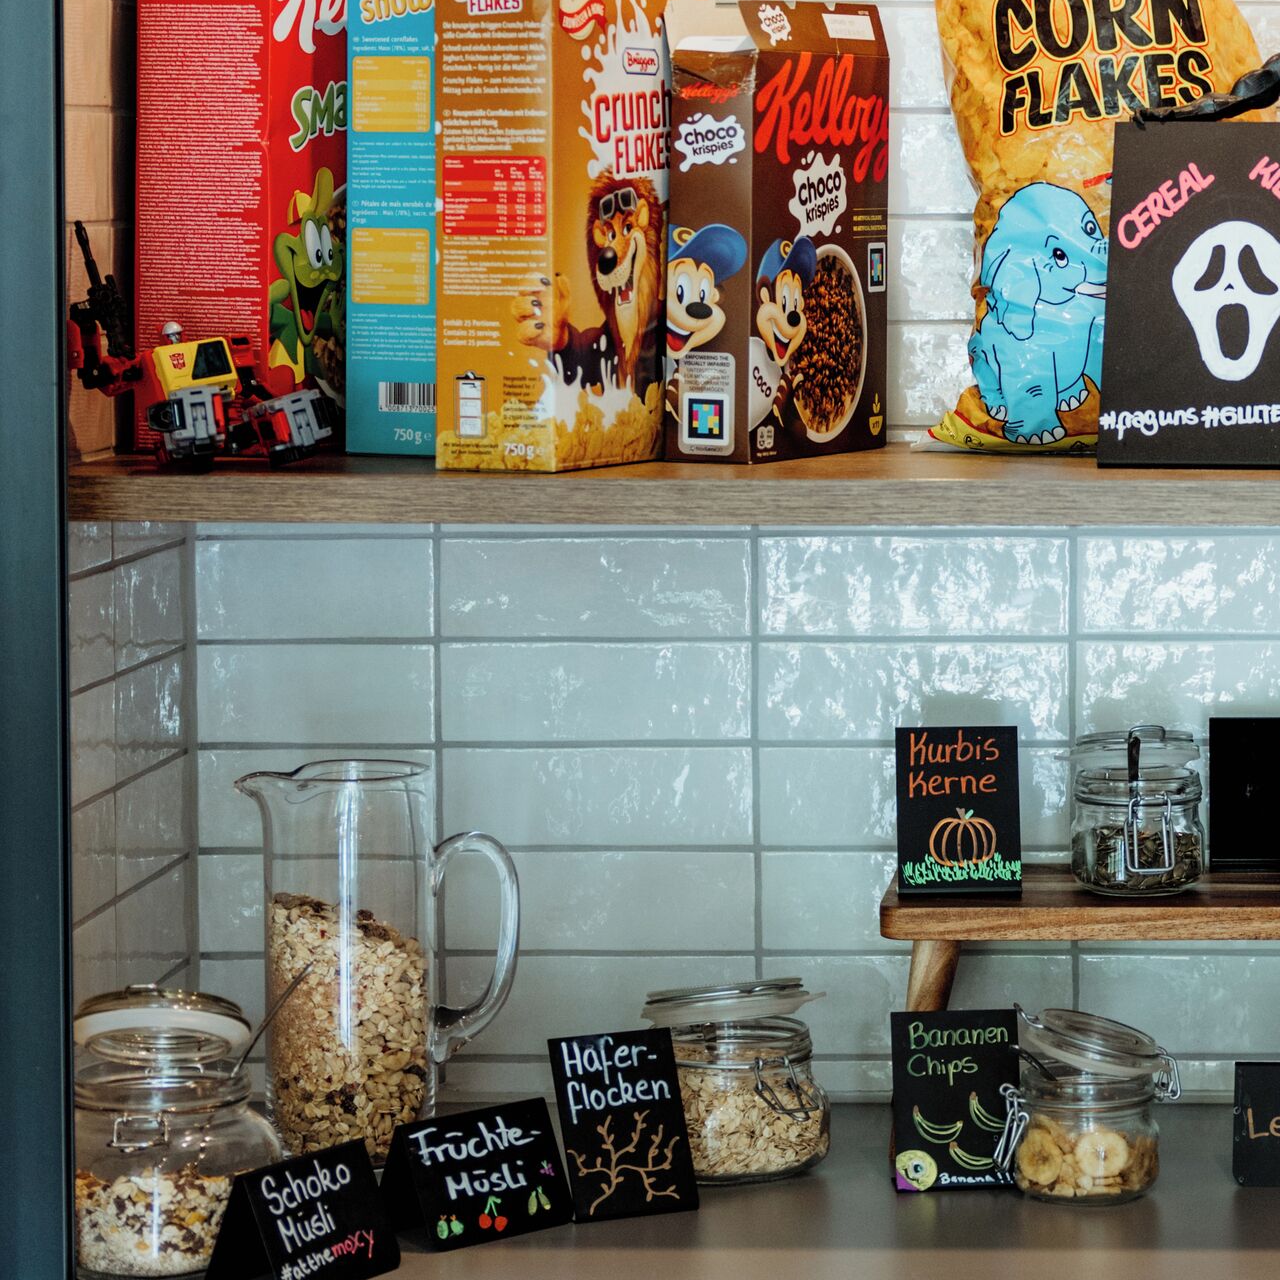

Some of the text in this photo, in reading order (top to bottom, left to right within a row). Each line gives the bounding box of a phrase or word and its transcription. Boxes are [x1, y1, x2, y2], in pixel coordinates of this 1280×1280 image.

[626, 51, 656, 74] Brüggen
[1001, 49, 1213, 135] FLAKES
[684, 126, 737, 145] choco
[692, 140, 734, 156] krispies
[798, 171, 842, 205] choco
[806, 195, 839, 224] krispies
[1117, 162, 1215, 250] CEREAL
[752, 366, 772, 398] COCO
[908, 770, 998, 799] Kerne
[908, 1021, 1009, 1050] Bananen
[907, 1054, 978, 1086] Chips
[567, 1072, 671, 1124] flocken
[261, 1159, 351, 1215] Schoko
